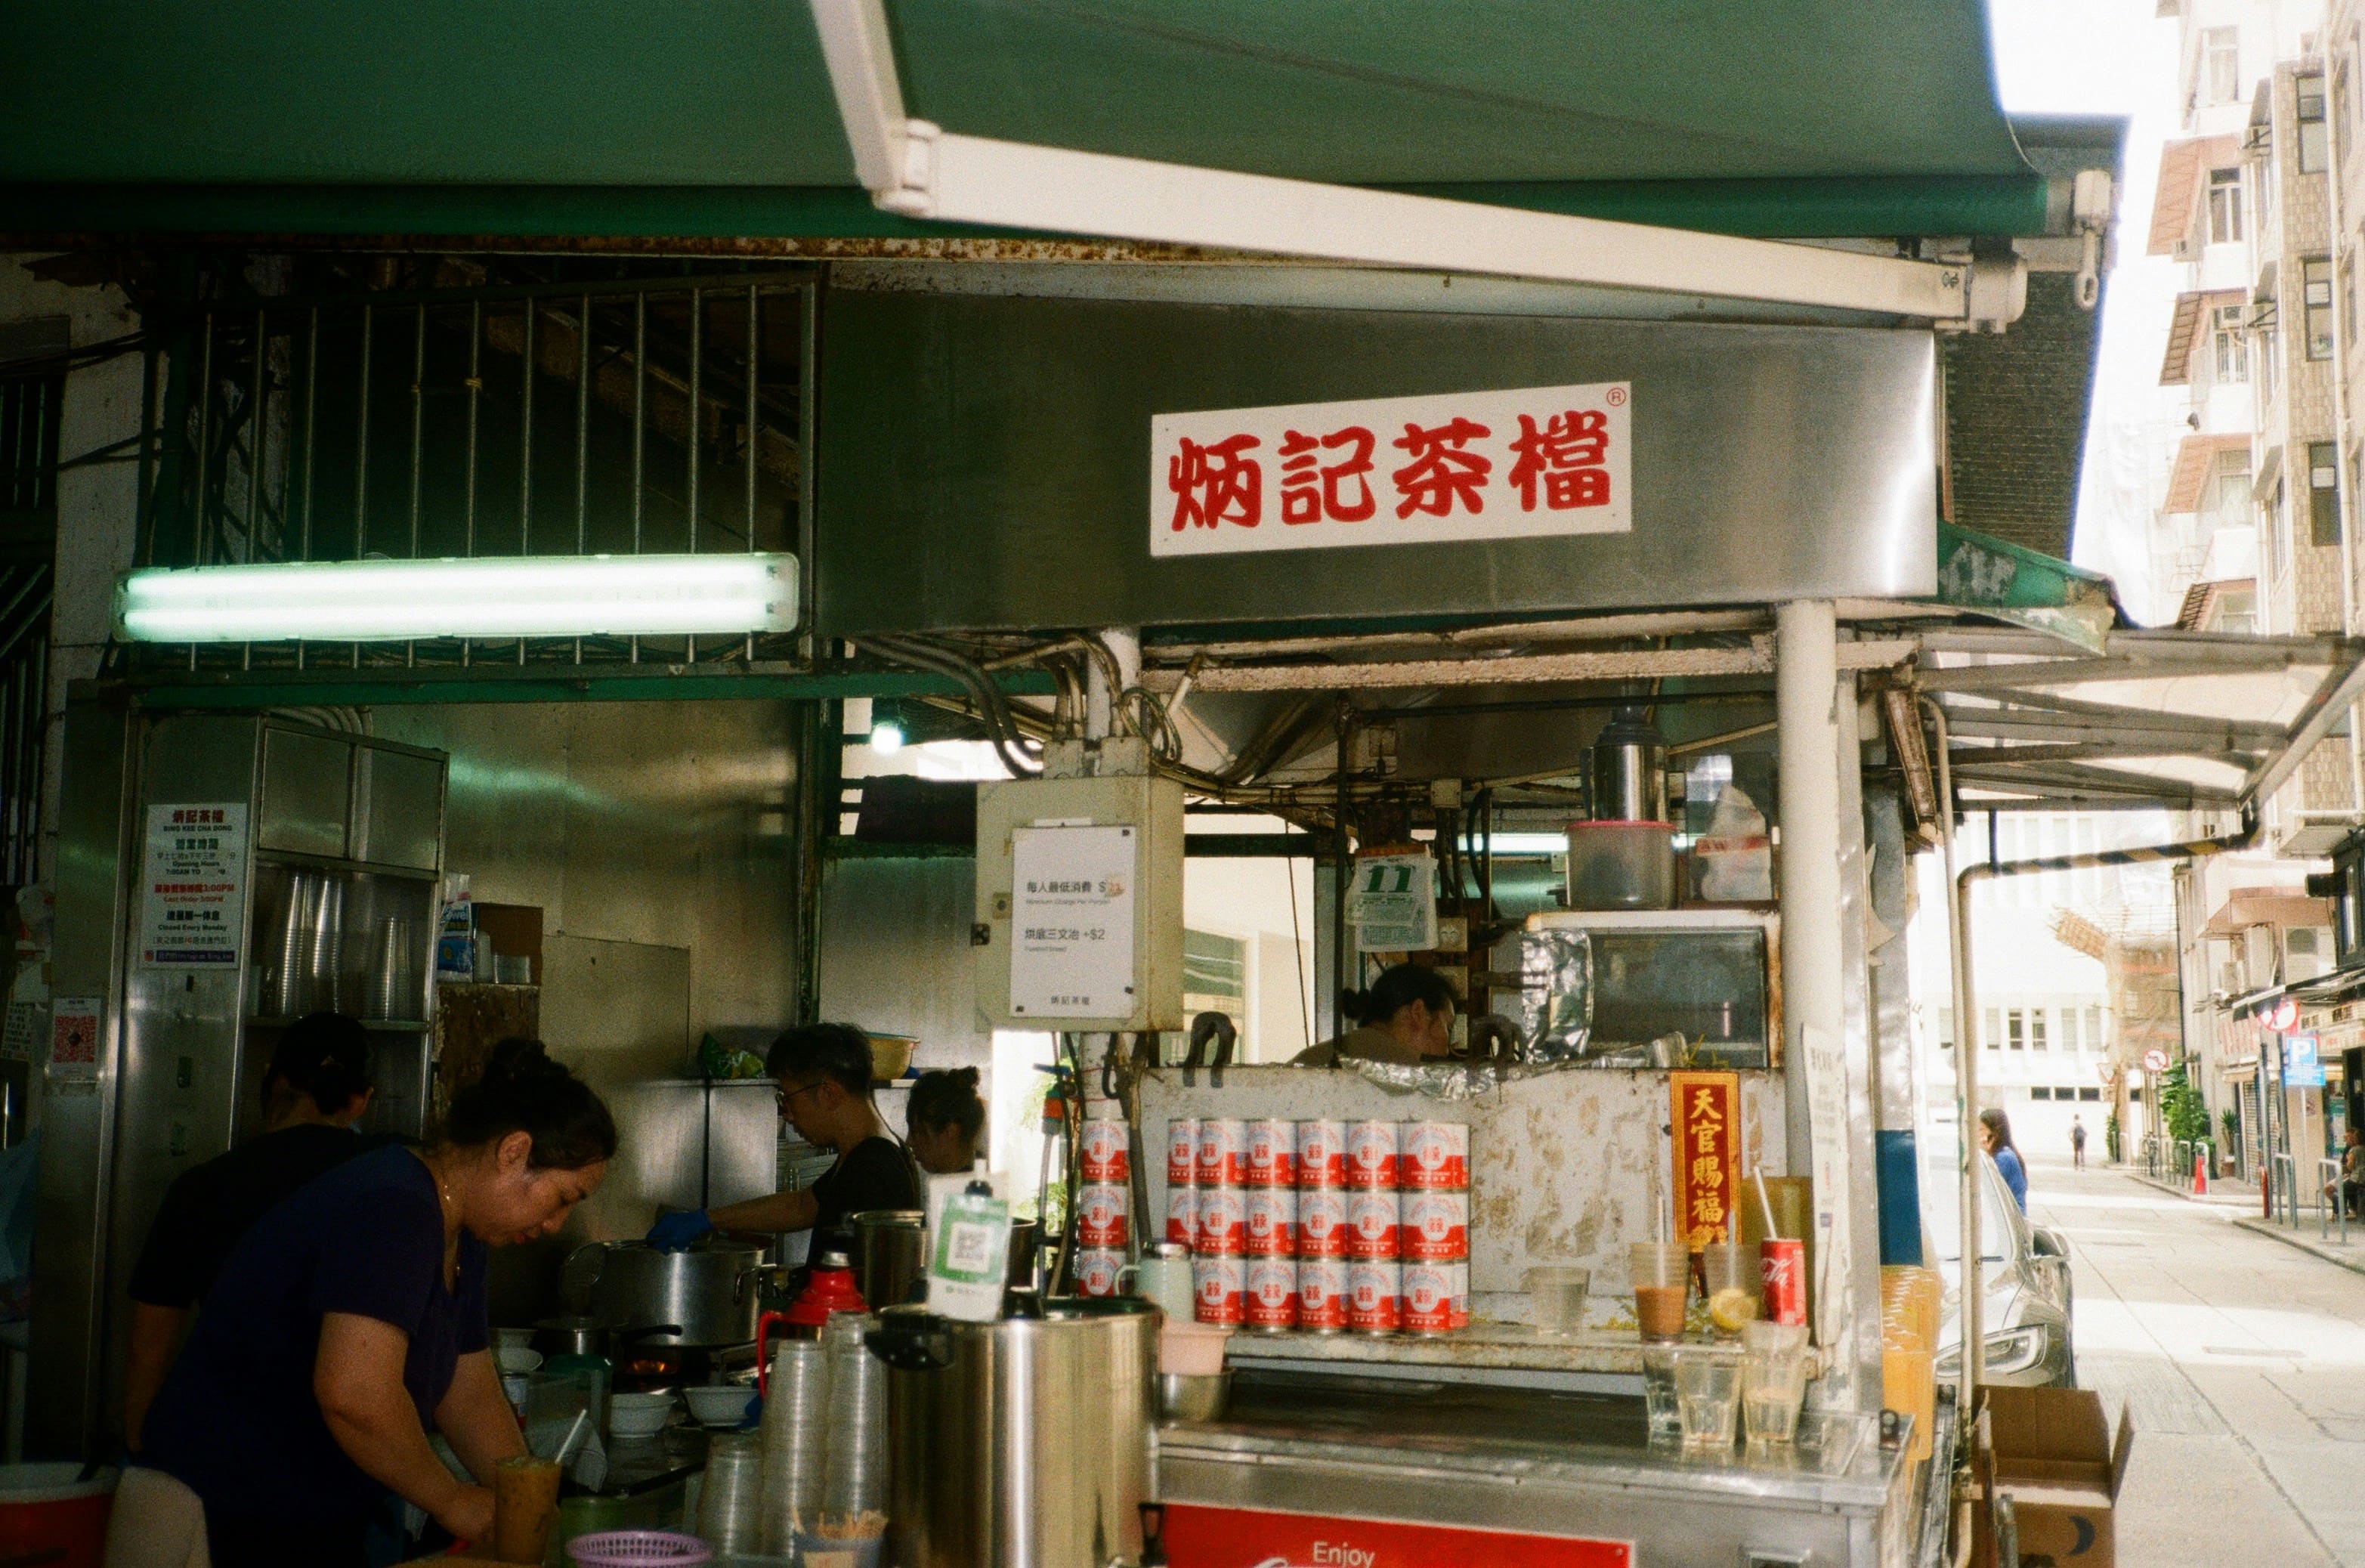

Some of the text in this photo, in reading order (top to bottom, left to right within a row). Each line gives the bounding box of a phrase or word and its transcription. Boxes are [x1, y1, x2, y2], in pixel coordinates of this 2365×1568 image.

[1168, 409, 1611, 532] 炳記茶檔
[1360, 864, 1413, 893] 11
[1690, 1087, 1724, 1223] 天官賜福
[1313, 1540, 1375, 1568] Enjoy
